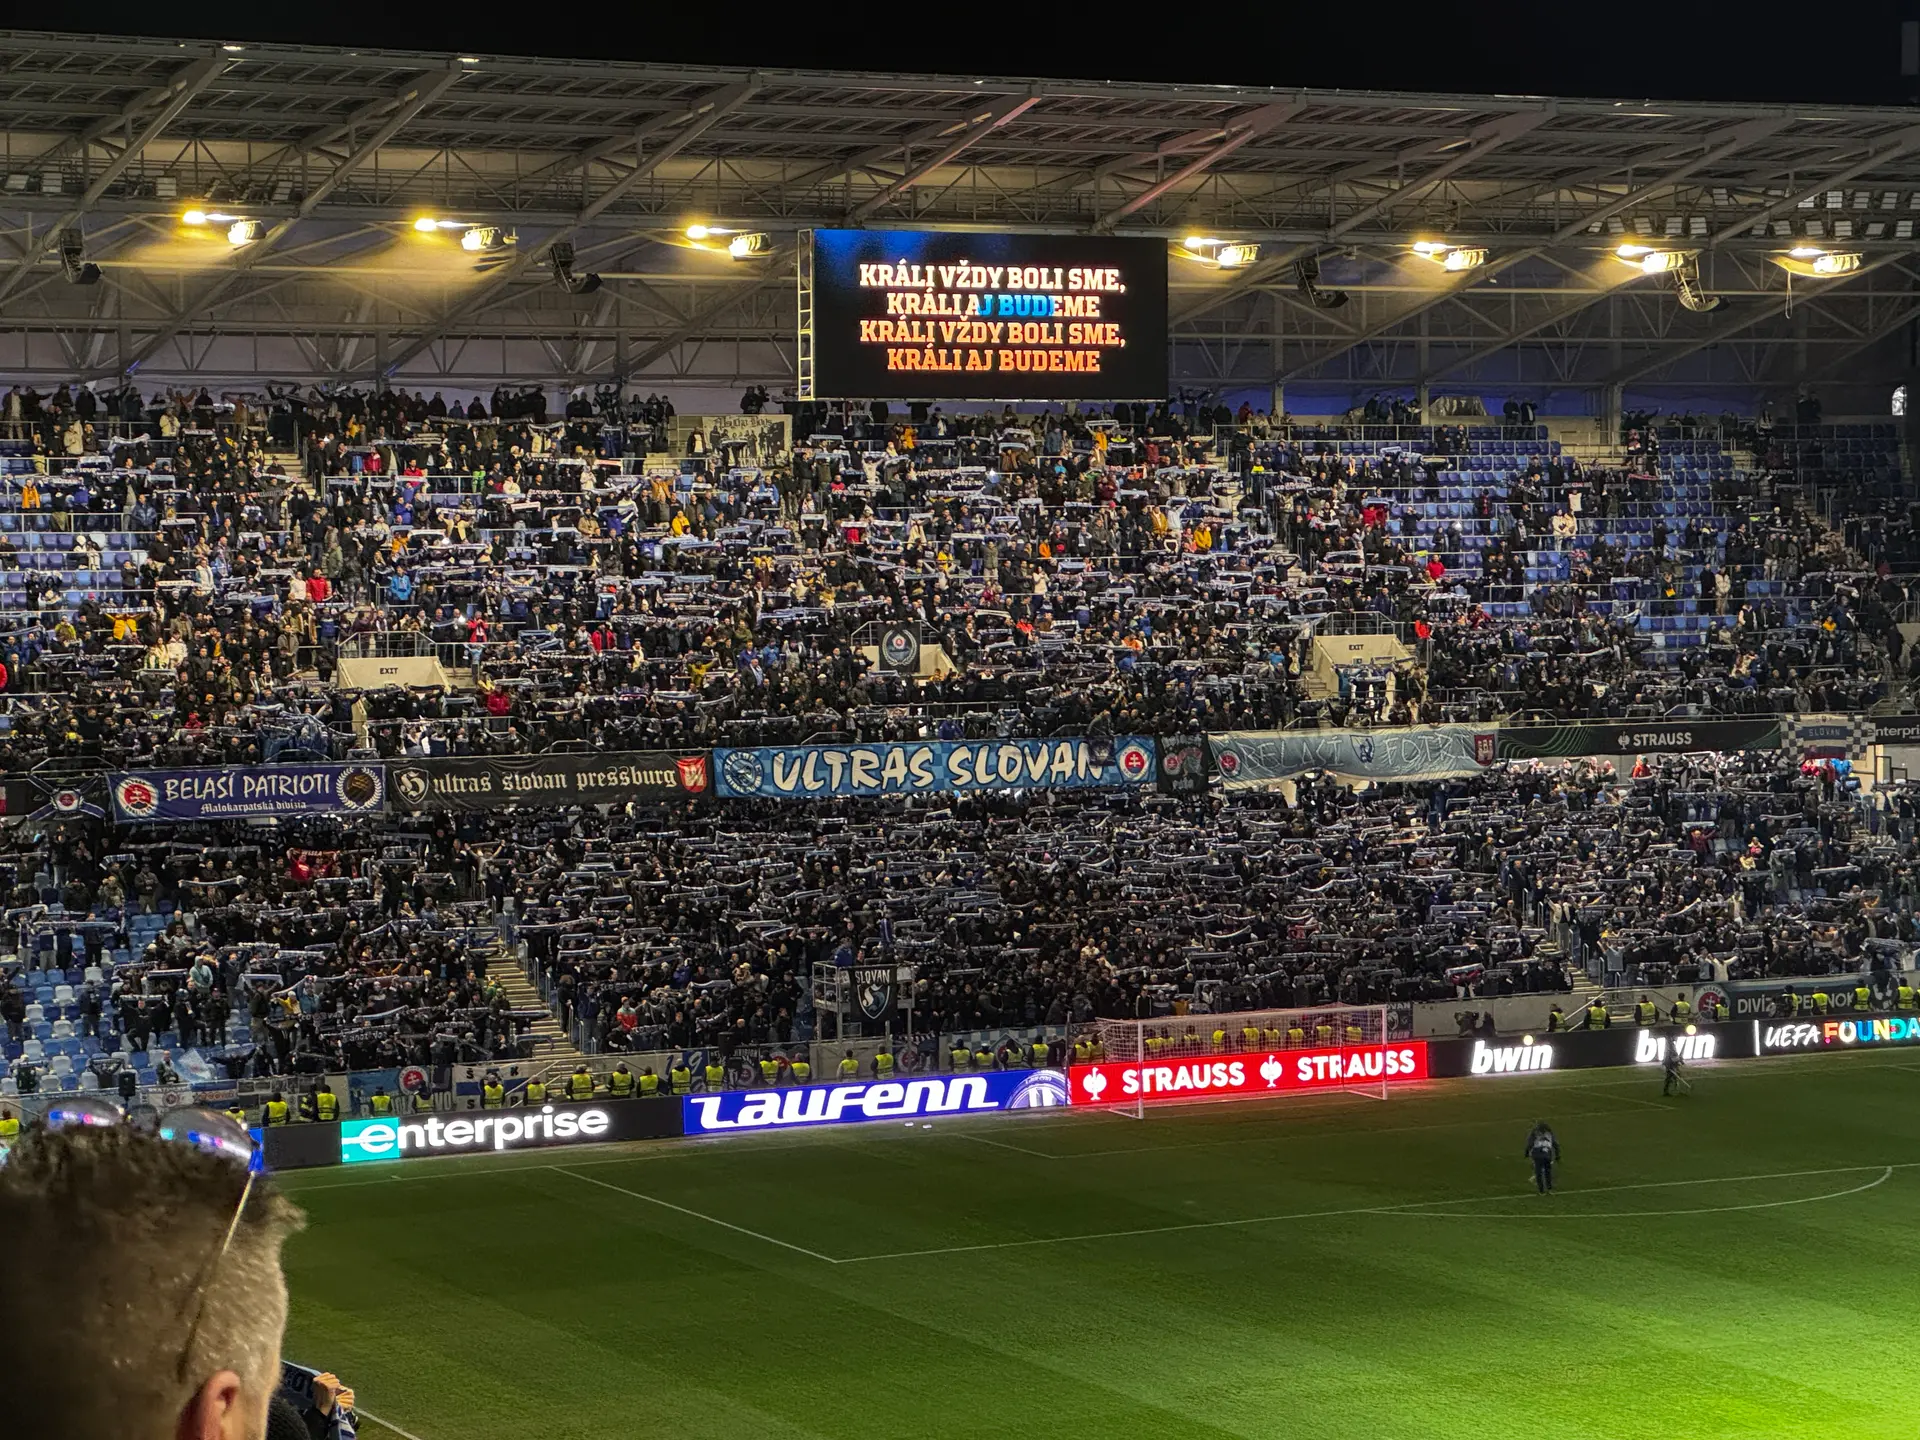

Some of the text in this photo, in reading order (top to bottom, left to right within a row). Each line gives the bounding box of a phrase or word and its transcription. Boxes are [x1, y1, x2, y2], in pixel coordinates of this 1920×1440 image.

[860, 259, 1126, 293] KRÁLI VŽDY BOLI SME,
[887, 288, 1100, 317] KRÁLI AJ BUDEME
[860, 315, 1126, 348] KRÁLI VŽDY BOLI SME,
[887, 343, 1101, 372] KRÁLI AJ BUDEME
[1348, 643, 1364, 651] EXIT
[379, 667, 399, 675] EXIT
[1632, 732, 1693, 747] STRAUSS
[432, 765, 677, 794] ultras slovan pressburg
[773, 744, 936, 792] ULTRAS
[946, 740, 1103, 786] SLOVAN
[164, 771, 236, 800] BELASÍ
[243, 773, 331, 799] PATRIOTI
[854, 968, 891, 985] SLOVAN
[1737, 991, 1855, 1014] DIVÍZ PENOK
[1764, 1017, 1920, 1048] UEFA FOUNDA
[1297, 1049, 1416, 1081] STRAUSS
[1470, 1034, 1553, 1075] bwin
[1122, 1061, 1246, 1094] STRAUSS
[690, 1076, 1000, 1131] Laufenn
[352, 1105, 610, 1153] enterprise
